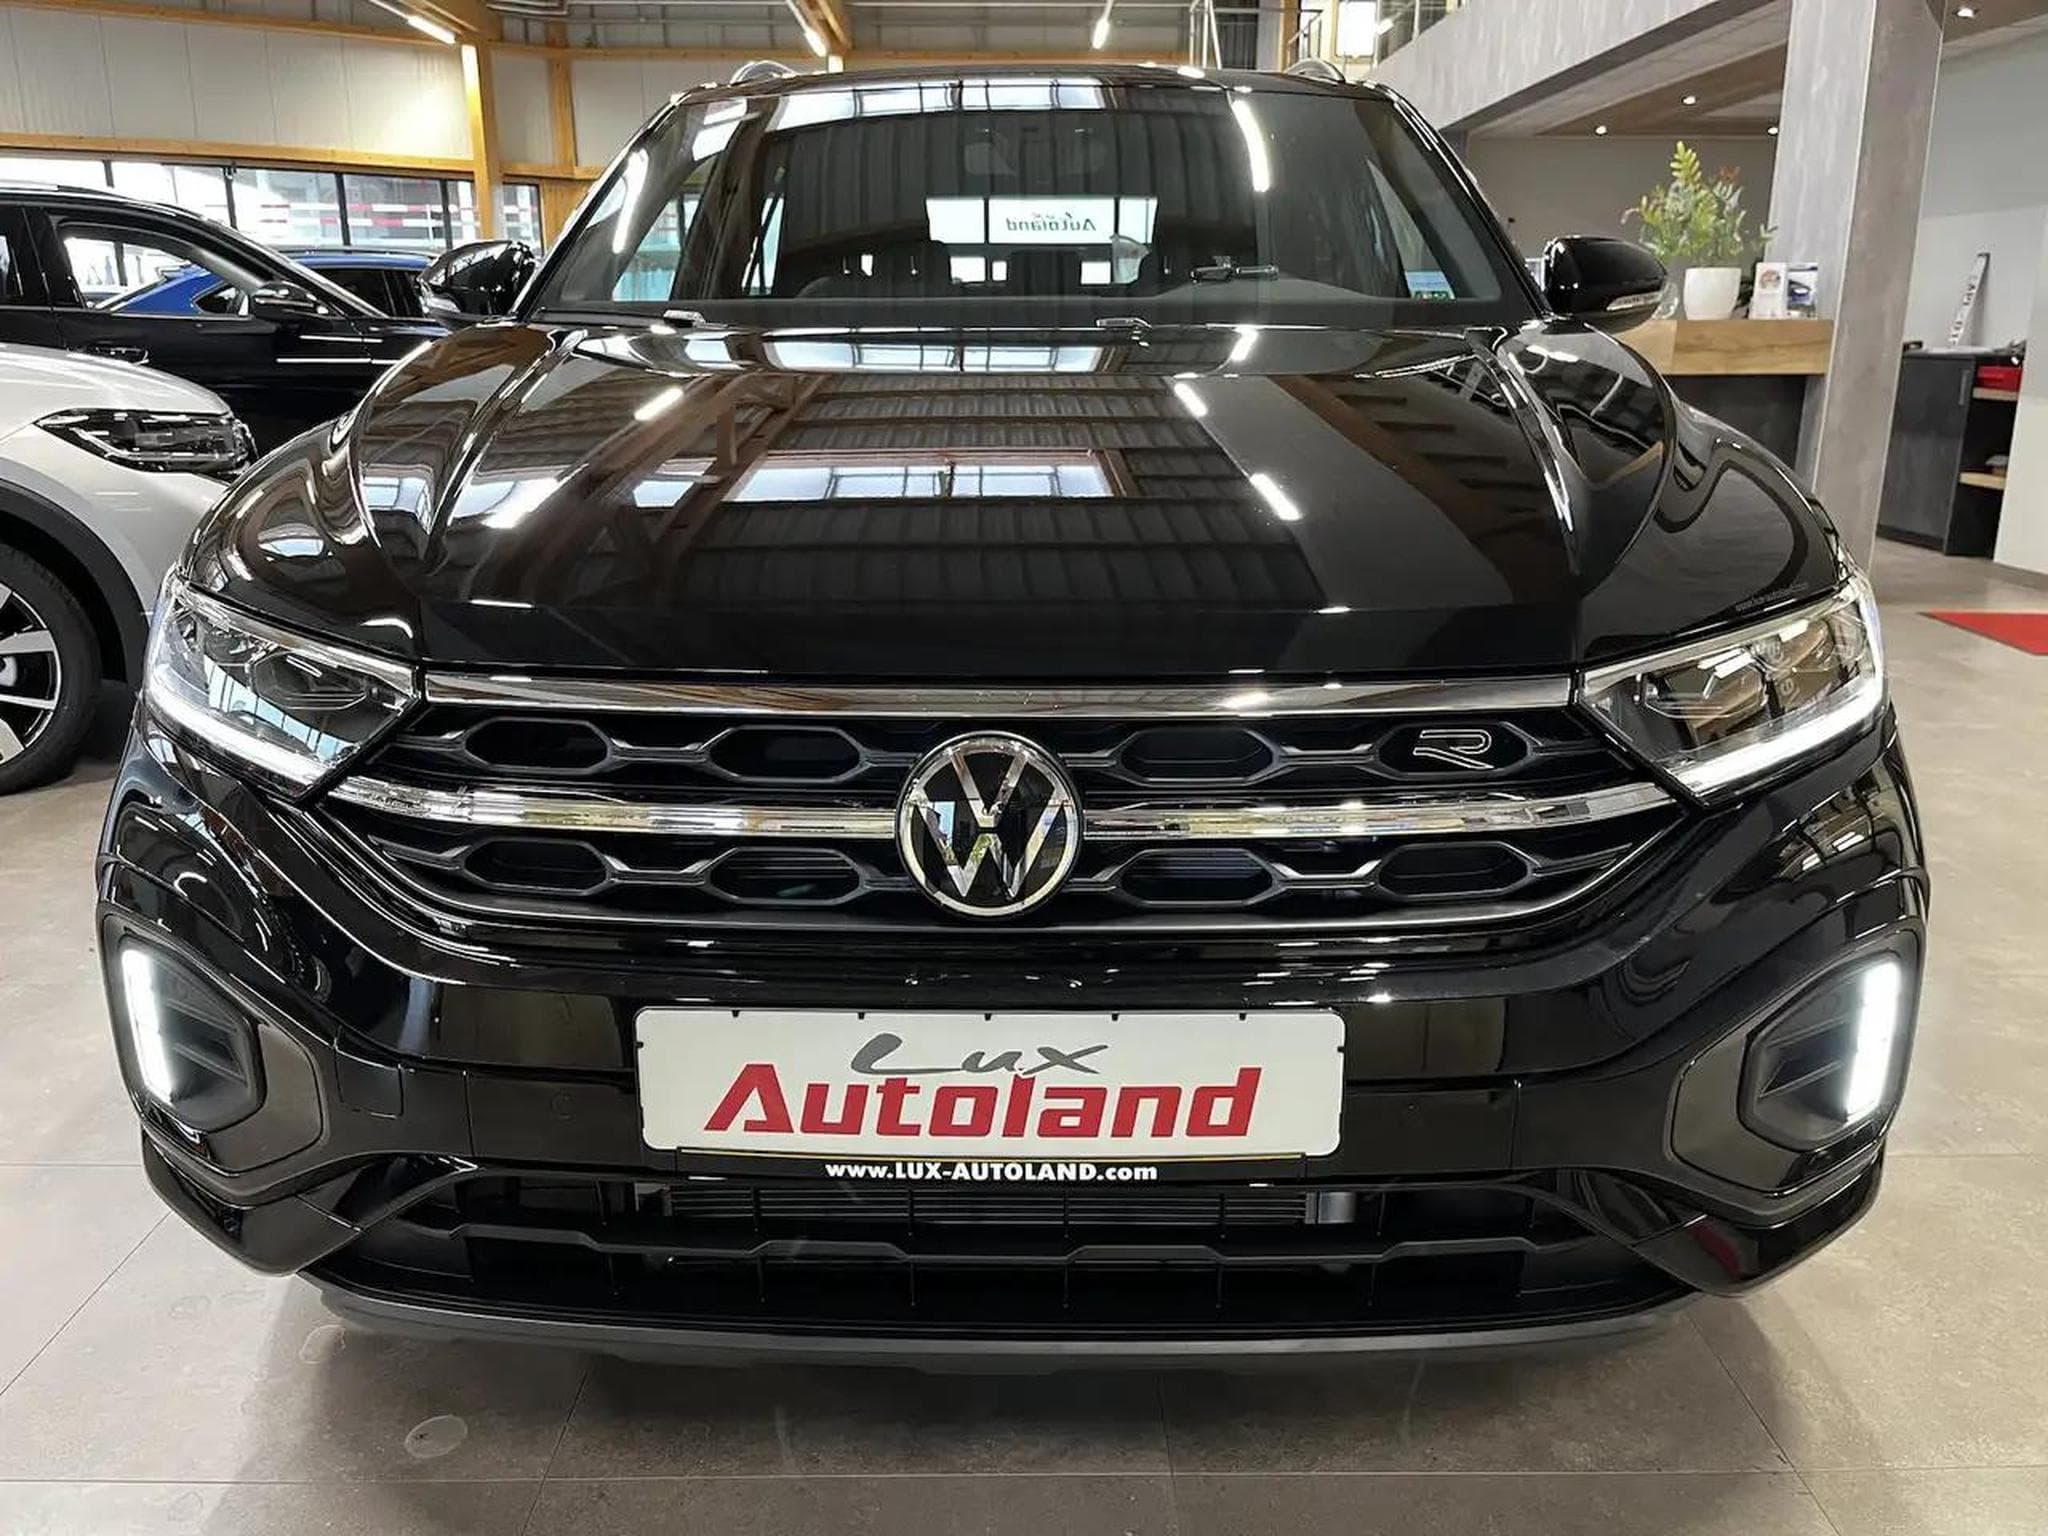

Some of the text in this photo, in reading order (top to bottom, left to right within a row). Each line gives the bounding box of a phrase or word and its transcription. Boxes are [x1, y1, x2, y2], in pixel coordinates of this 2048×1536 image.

[1413, 728, 1495, 770] R
[850, 1032, 1109, 1075] Lux
[704, 1063, 1263, 1138] Autoland
[825, 1161, 1158, 1182] www.LUX-AUTOLAND.com
